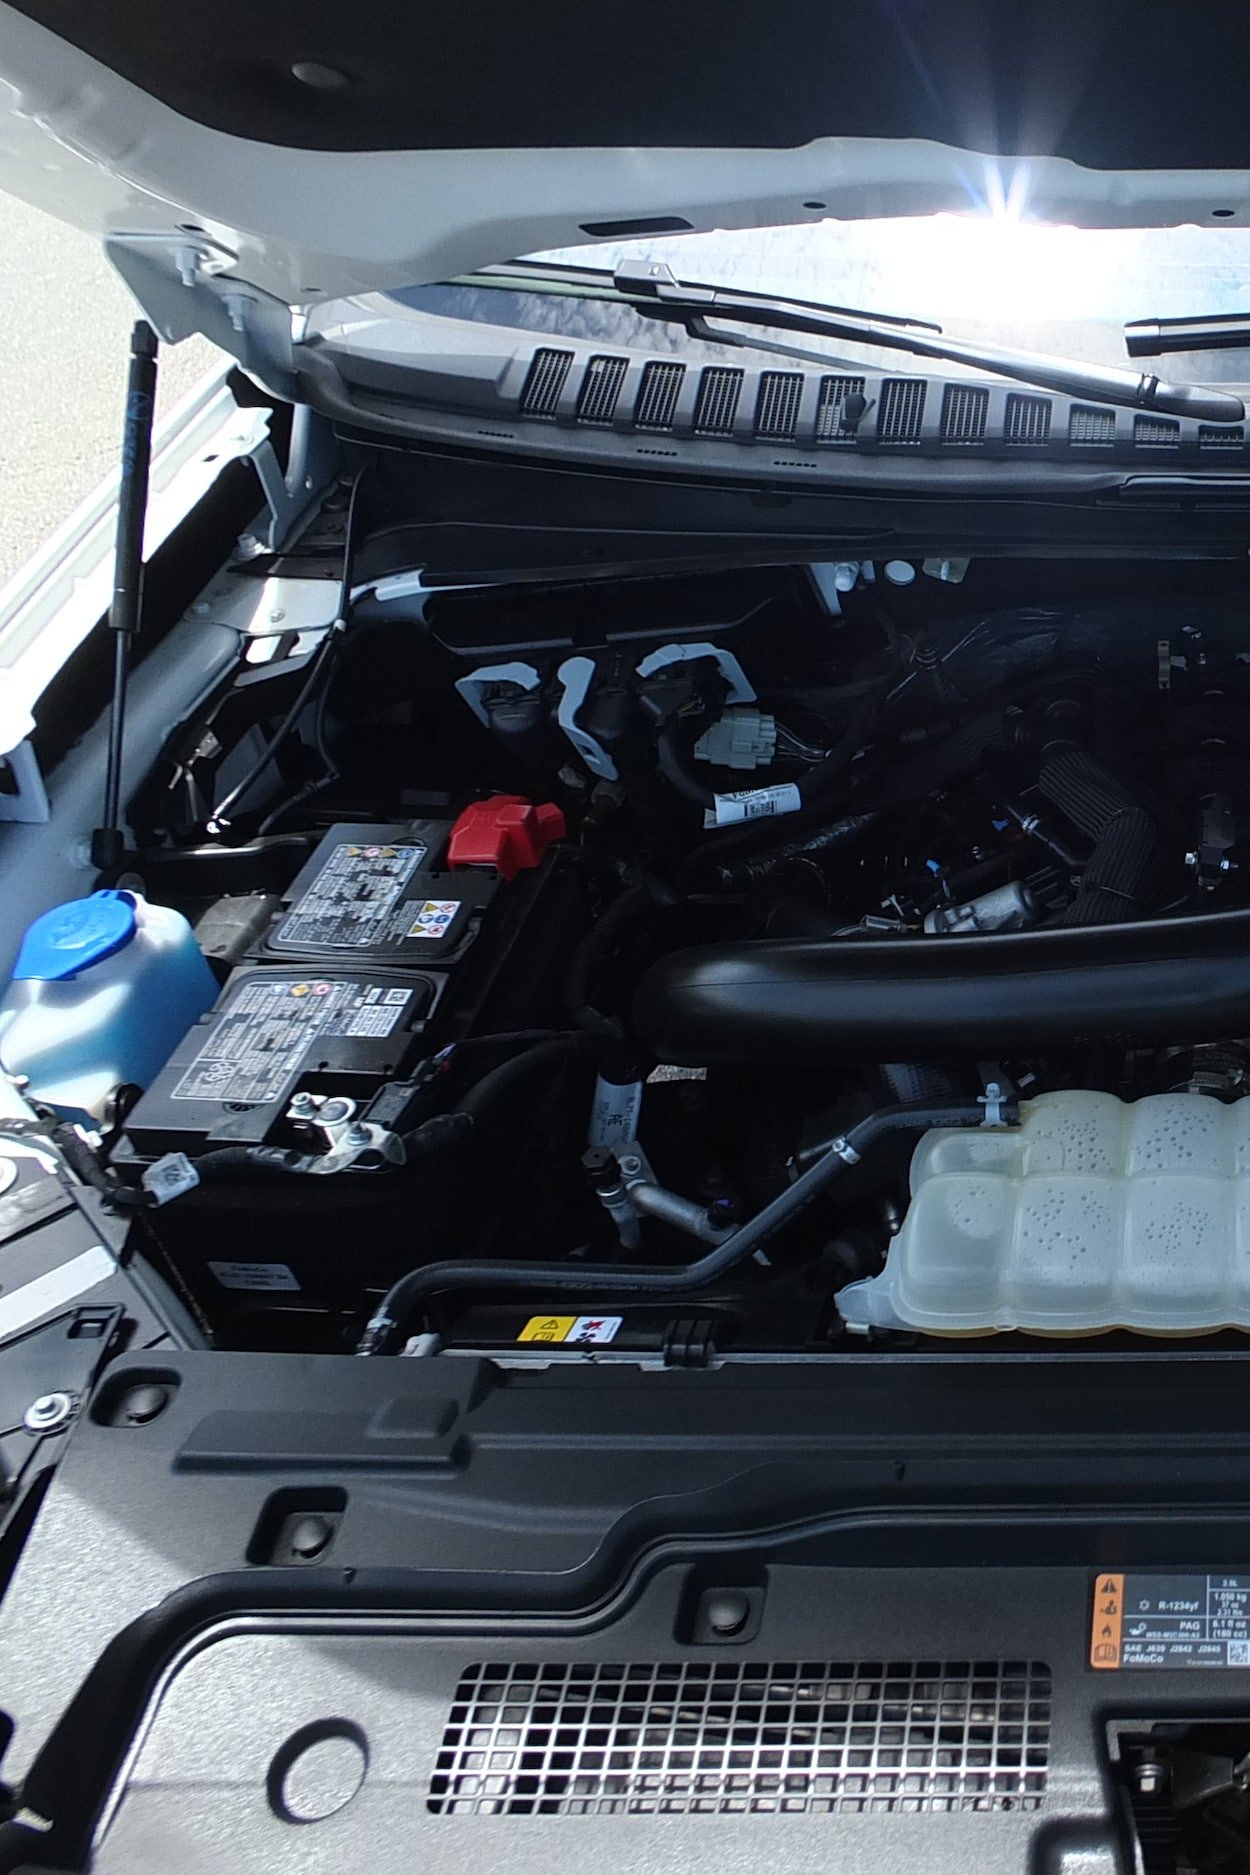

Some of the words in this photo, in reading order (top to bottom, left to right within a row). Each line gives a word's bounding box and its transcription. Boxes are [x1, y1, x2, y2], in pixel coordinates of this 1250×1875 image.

[1236, 1592, 1247, 1602] kg
[1158, 1600, 1199, 1612] R-1234yf
[1180, 1621, 1200, 1630] PAG
[1212, 1620, 1225, 1628] 6.1
[1226, 1620, 1235, 1628] fl
[1233, 1629, 1247, 1639] cc)
[1124, 1644, 1143, 1653] SAE
[1123, 1653, 1164, 1663] FoMoCo
